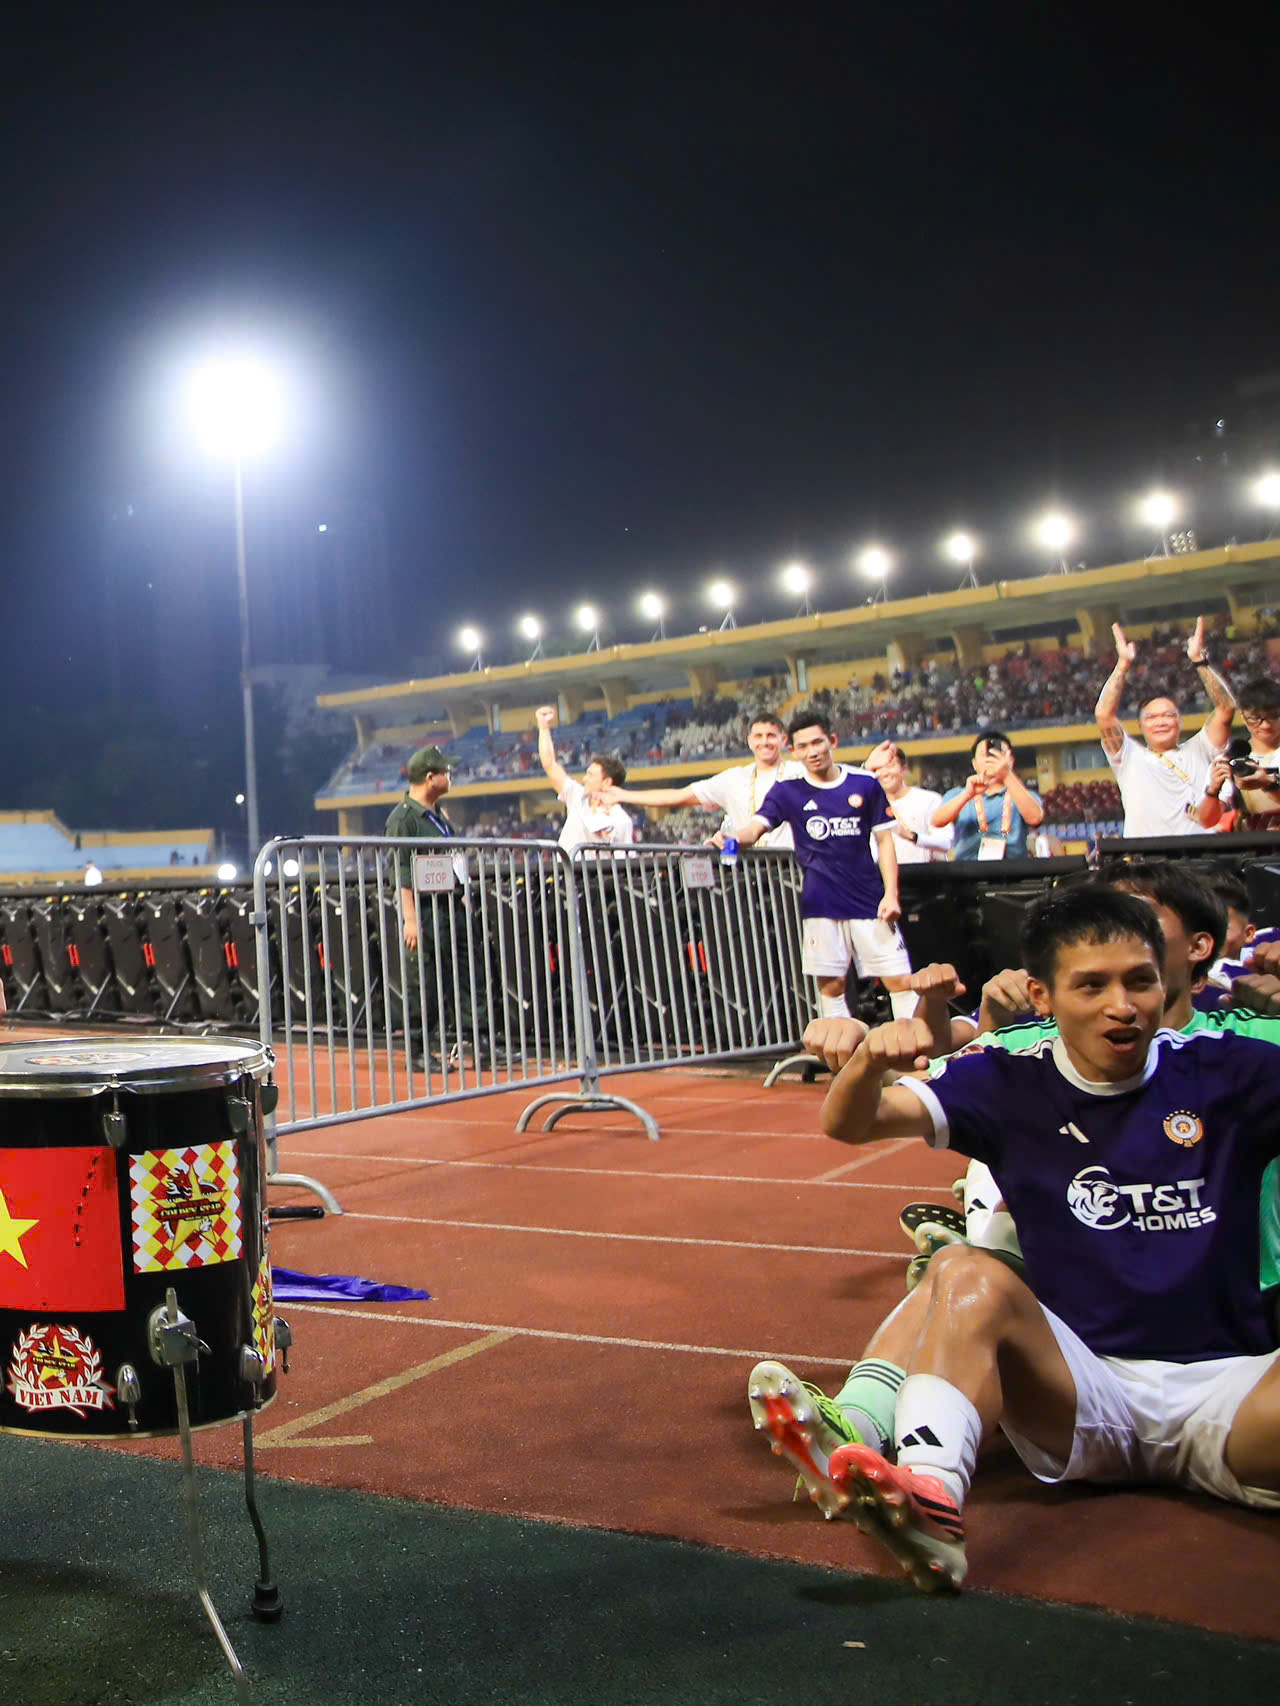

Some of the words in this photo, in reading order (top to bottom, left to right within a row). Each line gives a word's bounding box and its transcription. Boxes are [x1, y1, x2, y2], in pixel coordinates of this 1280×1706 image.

[829, 816, 861, 829] T&T
[831, 828, 861, 837] HOMES
[425, 872, 447, 884] STOP
[1118, 1178, 1206, 1214] T&T
[1132, 1206, 1217, 1232] HOMES
[20, 1389, 54, 1406] VIET
[60, 1389, 100, 1405] NAM
